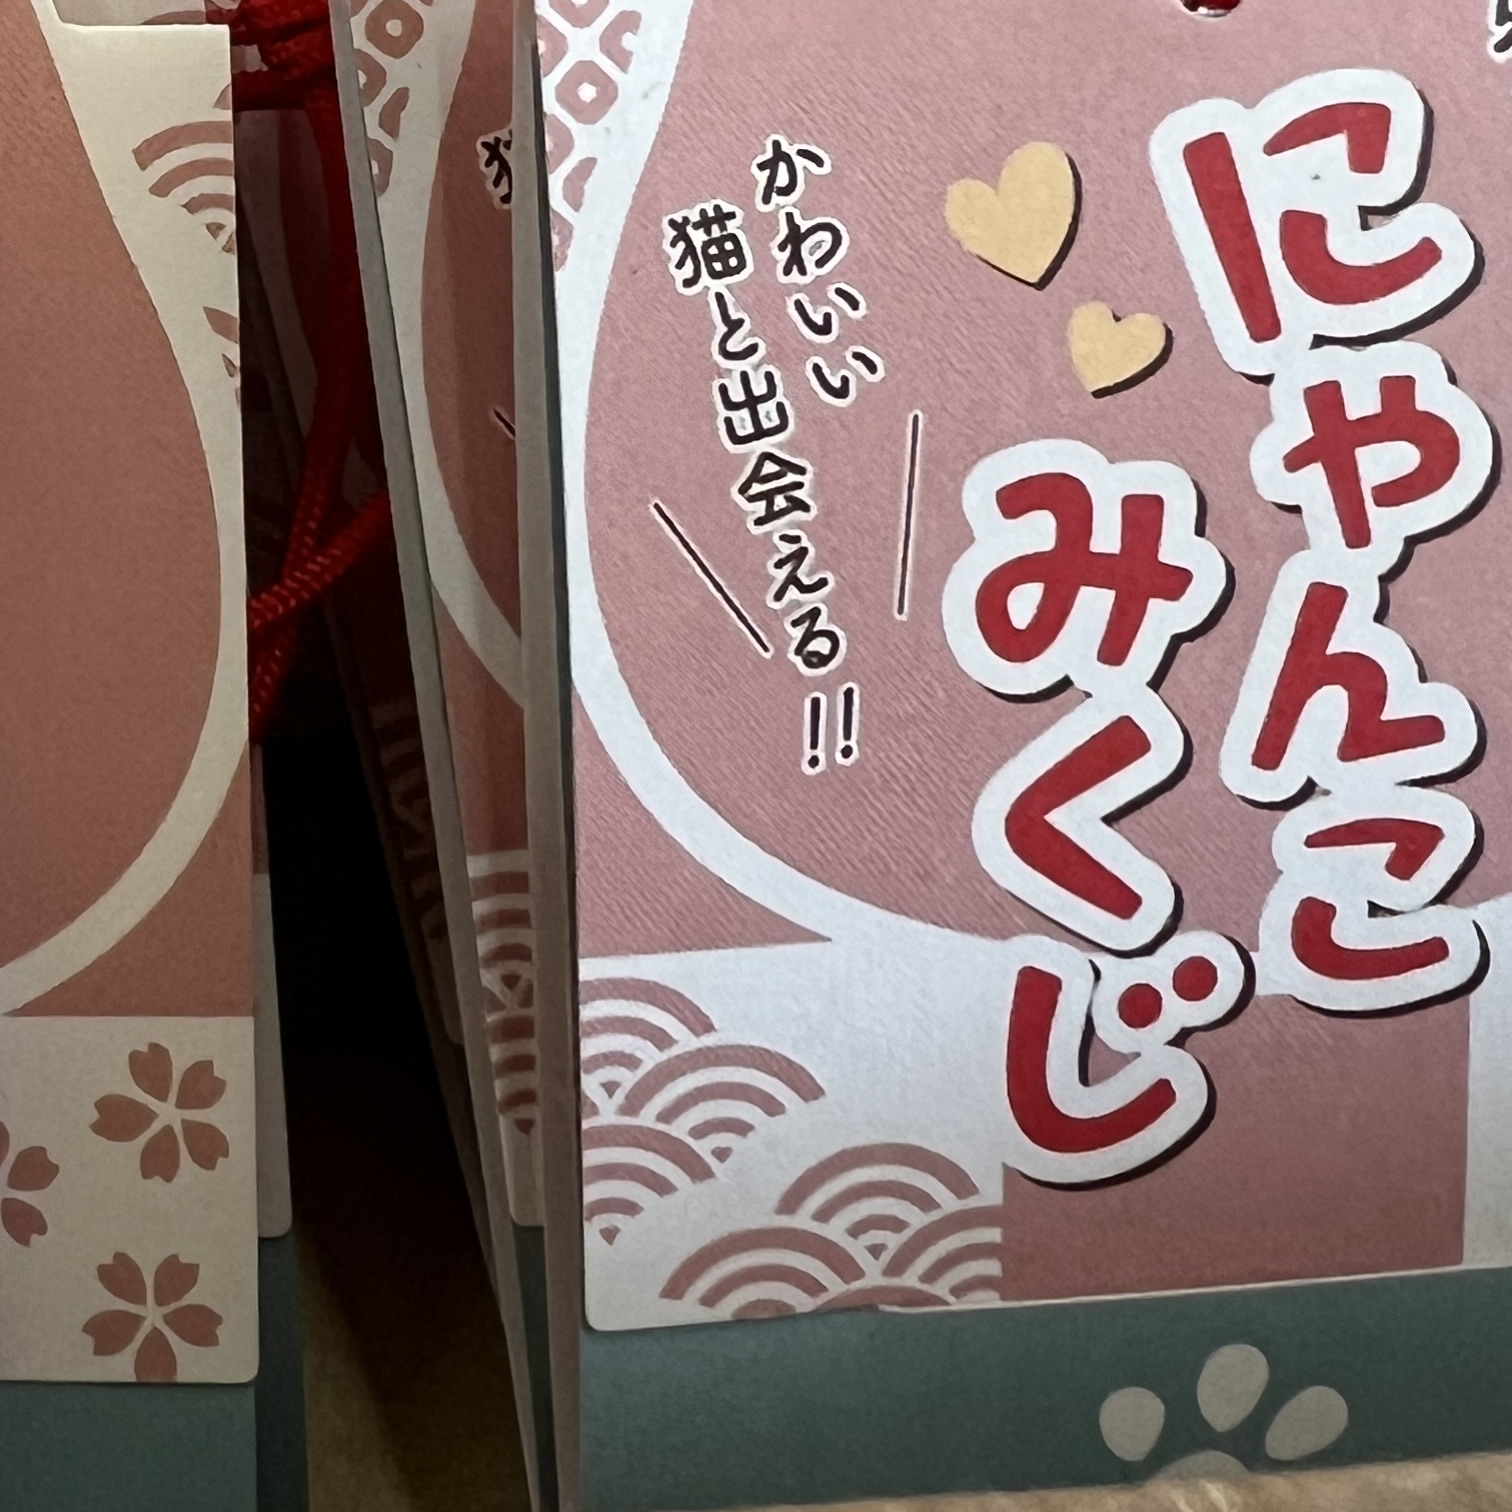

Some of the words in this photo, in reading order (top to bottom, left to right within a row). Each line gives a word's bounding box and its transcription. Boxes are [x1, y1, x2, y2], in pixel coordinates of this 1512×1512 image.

[758, 138, 880, 400] かわいい
[975, 471, 1218, 1155] みくじ
